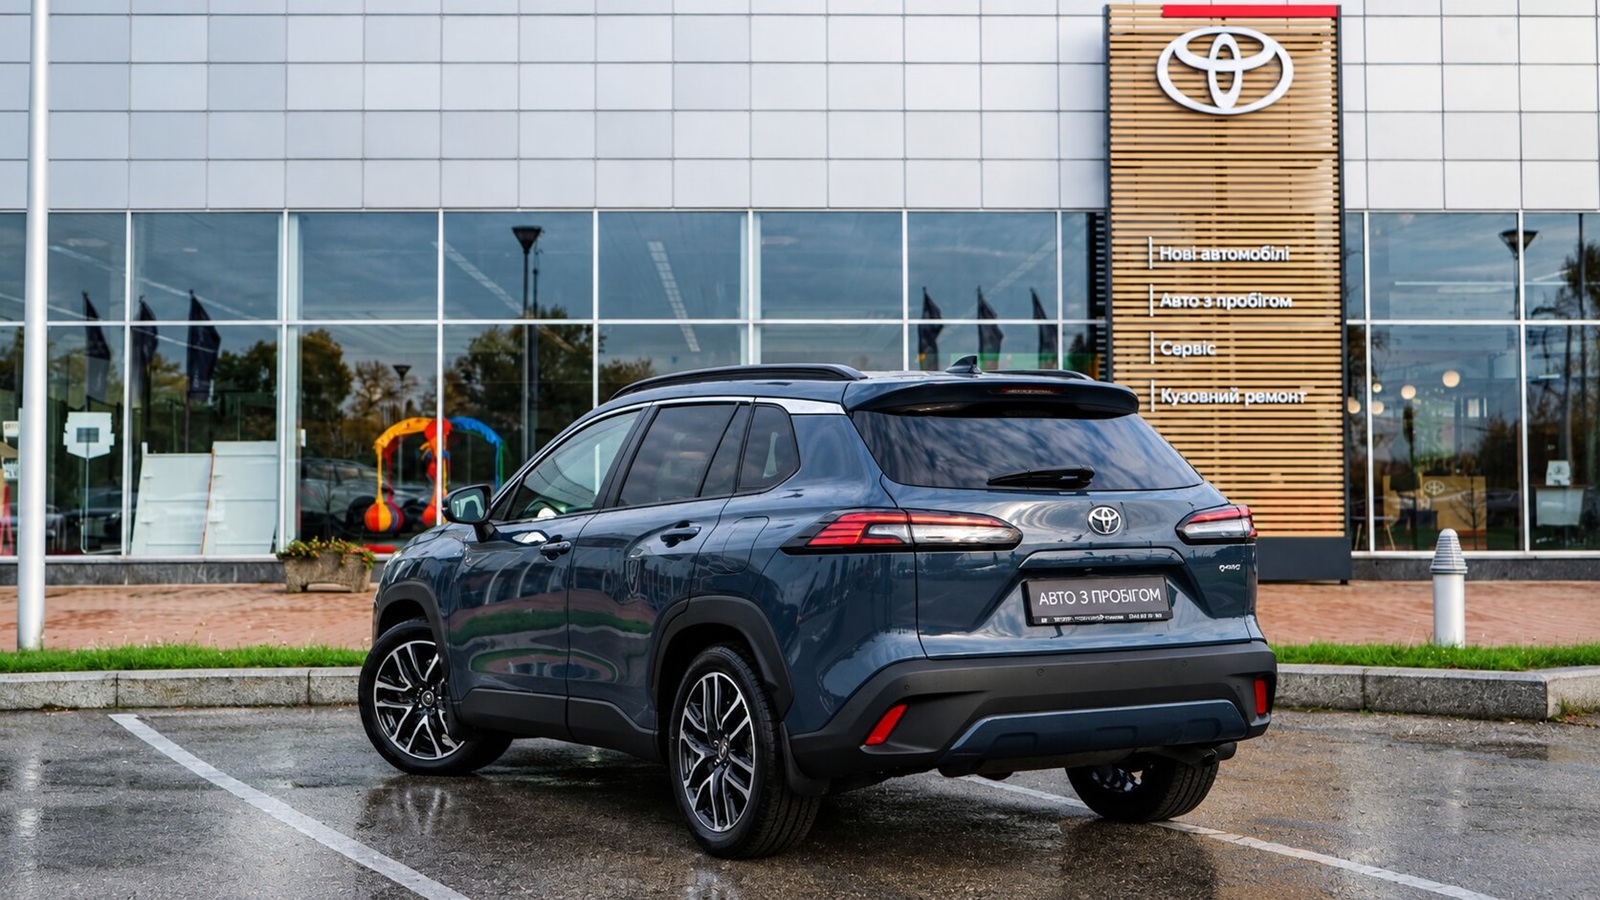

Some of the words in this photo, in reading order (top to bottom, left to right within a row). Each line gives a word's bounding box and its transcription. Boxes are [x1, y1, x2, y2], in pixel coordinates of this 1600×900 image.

[1159, 246, 1196, 261] Нові
[1201, 246, 1290, 261] автомобілі
[1160, 293, 1200, 308] Авто
[1203, 296, 1213, 308] з
[1216, 292, 1293, 310] пробігом
[1160, 340, 1217, 358] Сервіс
[1160, 387, 1241, 406] Кузовний
[1245, 390, 1308, 406] ремонт
[1039, 591, 1076, 606] АВТО
[1079, 590, 1089, 605] З
[1091, 588, 1162, 604] ПРОБІГОМ
